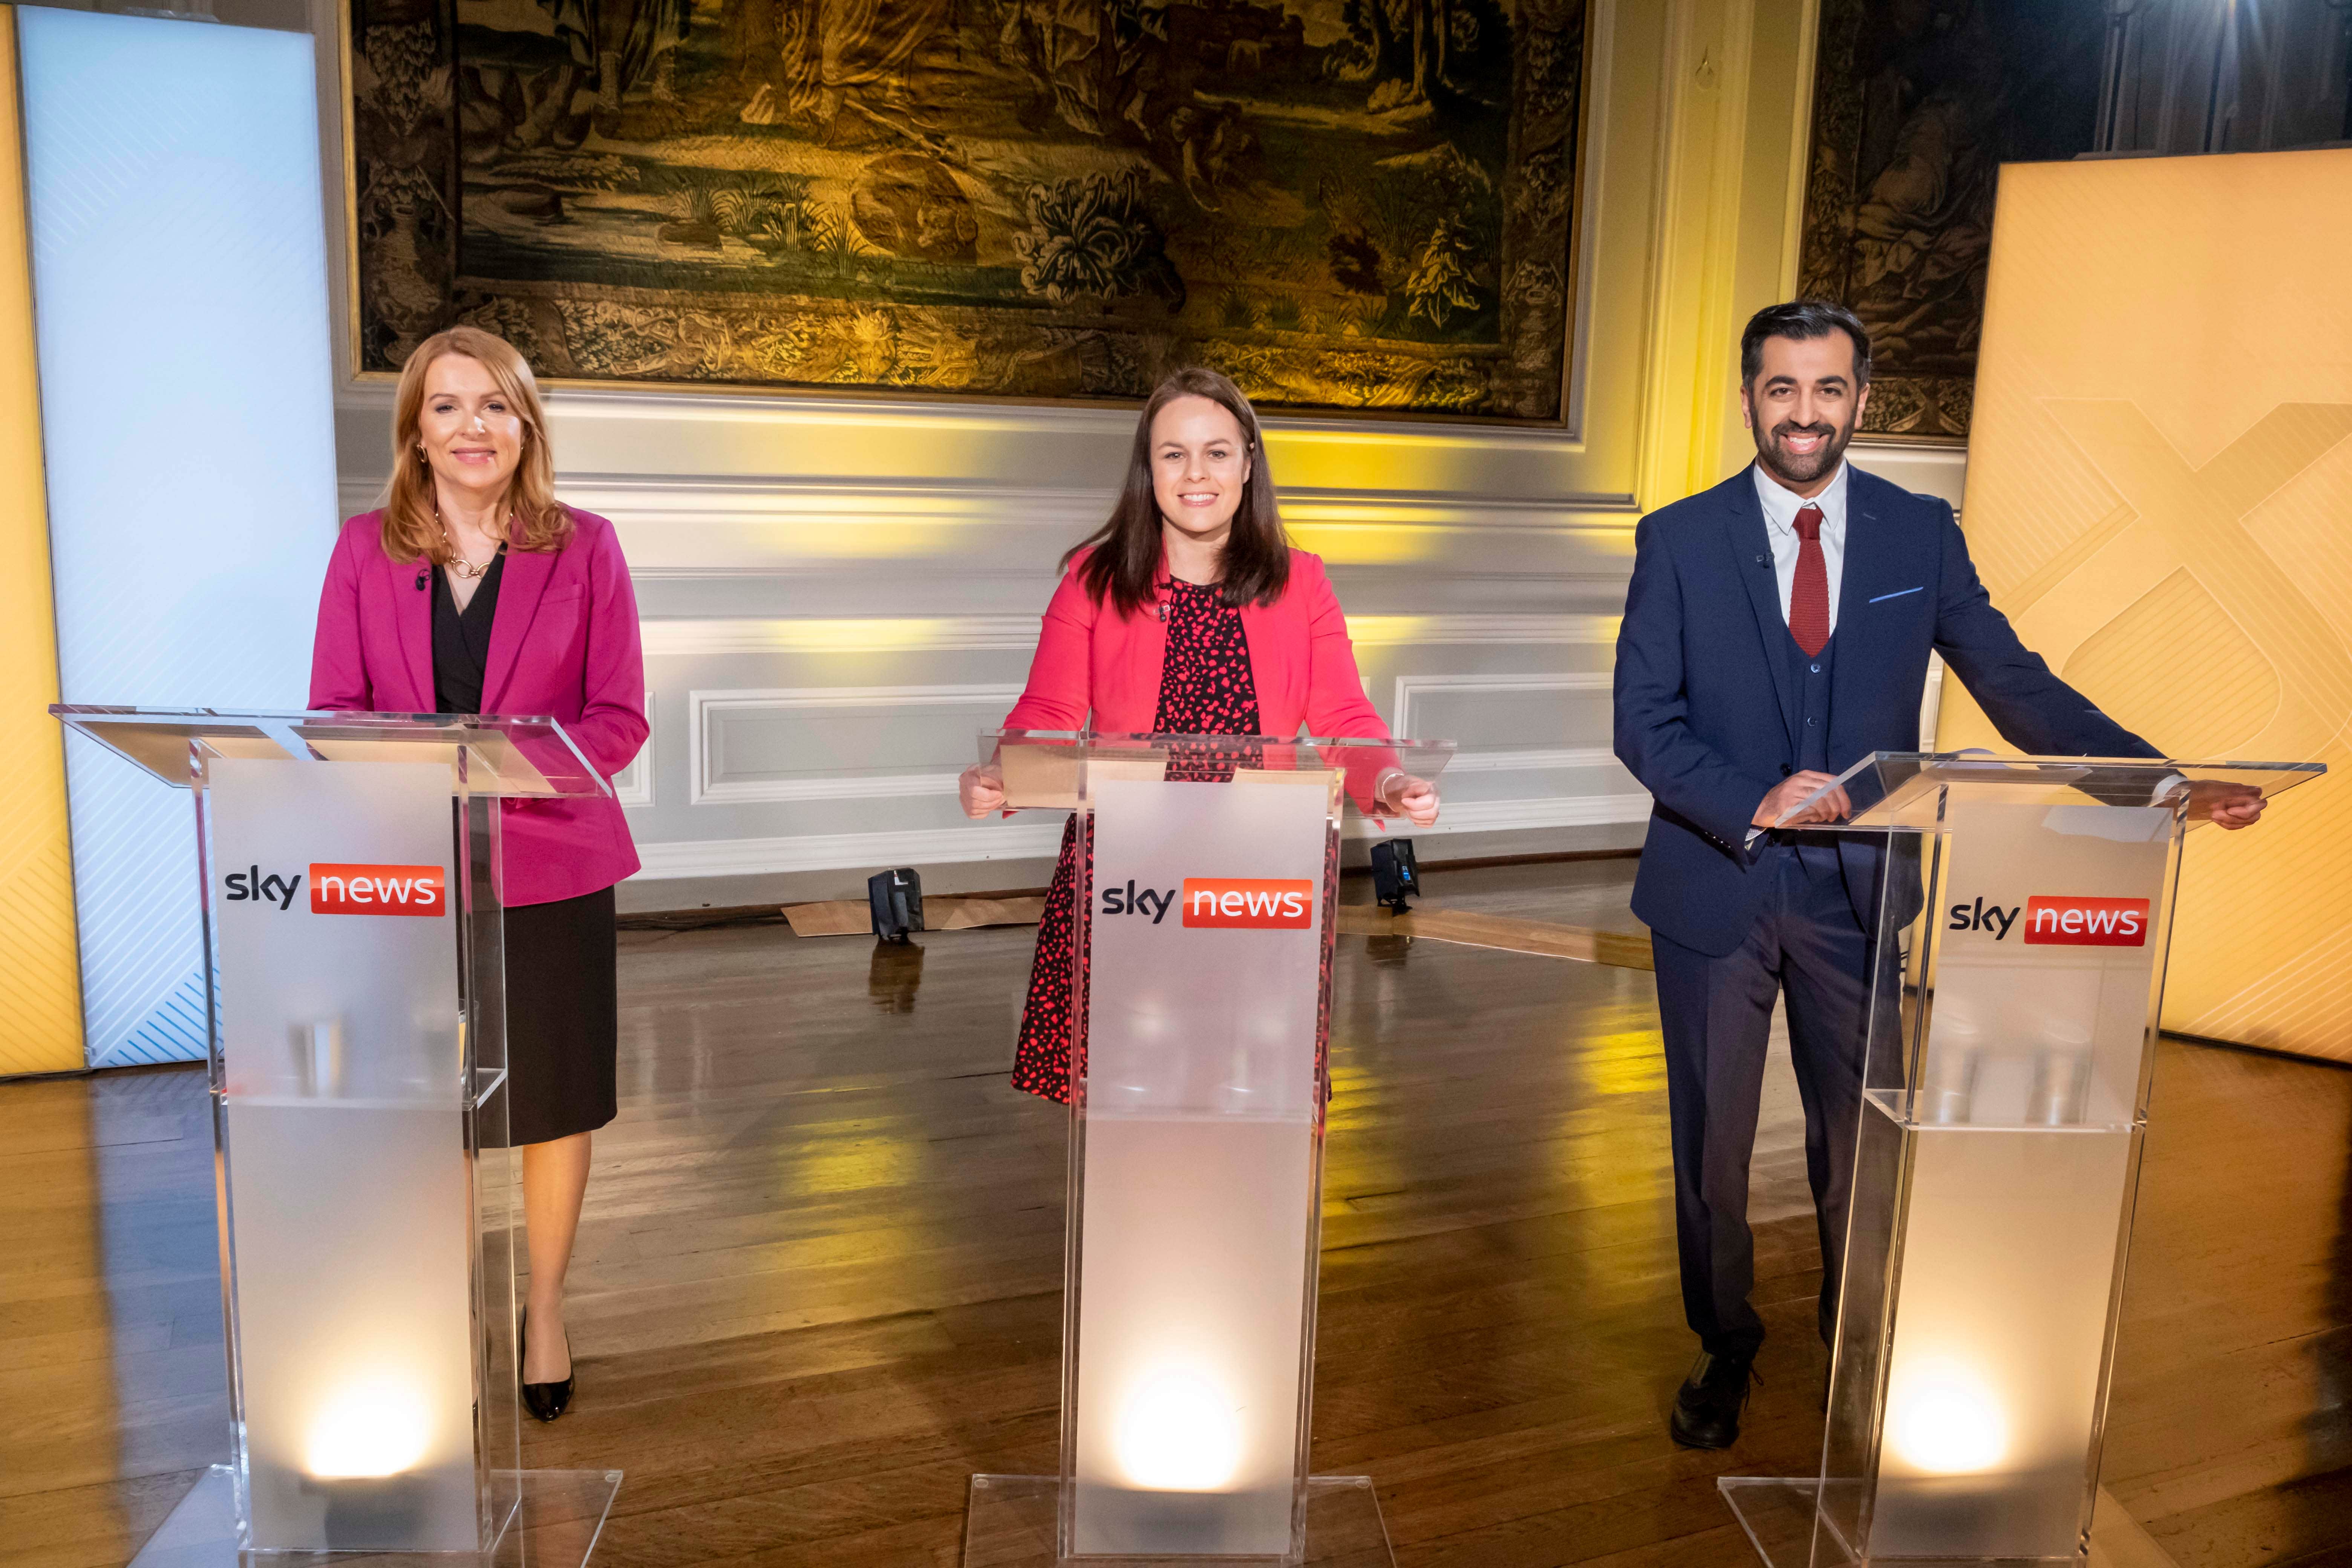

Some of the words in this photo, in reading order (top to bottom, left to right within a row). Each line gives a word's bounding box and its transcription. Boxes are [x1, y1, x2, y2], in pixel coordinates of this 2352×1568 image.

[225, 865, 302, 910] sky
[321, 876, 436, 904] news
[1102, 879, 1176, 924] sky
[1194, 891, 1303, 917] news
[1949, 896, 2021, 940] sky
[2035, 908, 2139, 935] news
